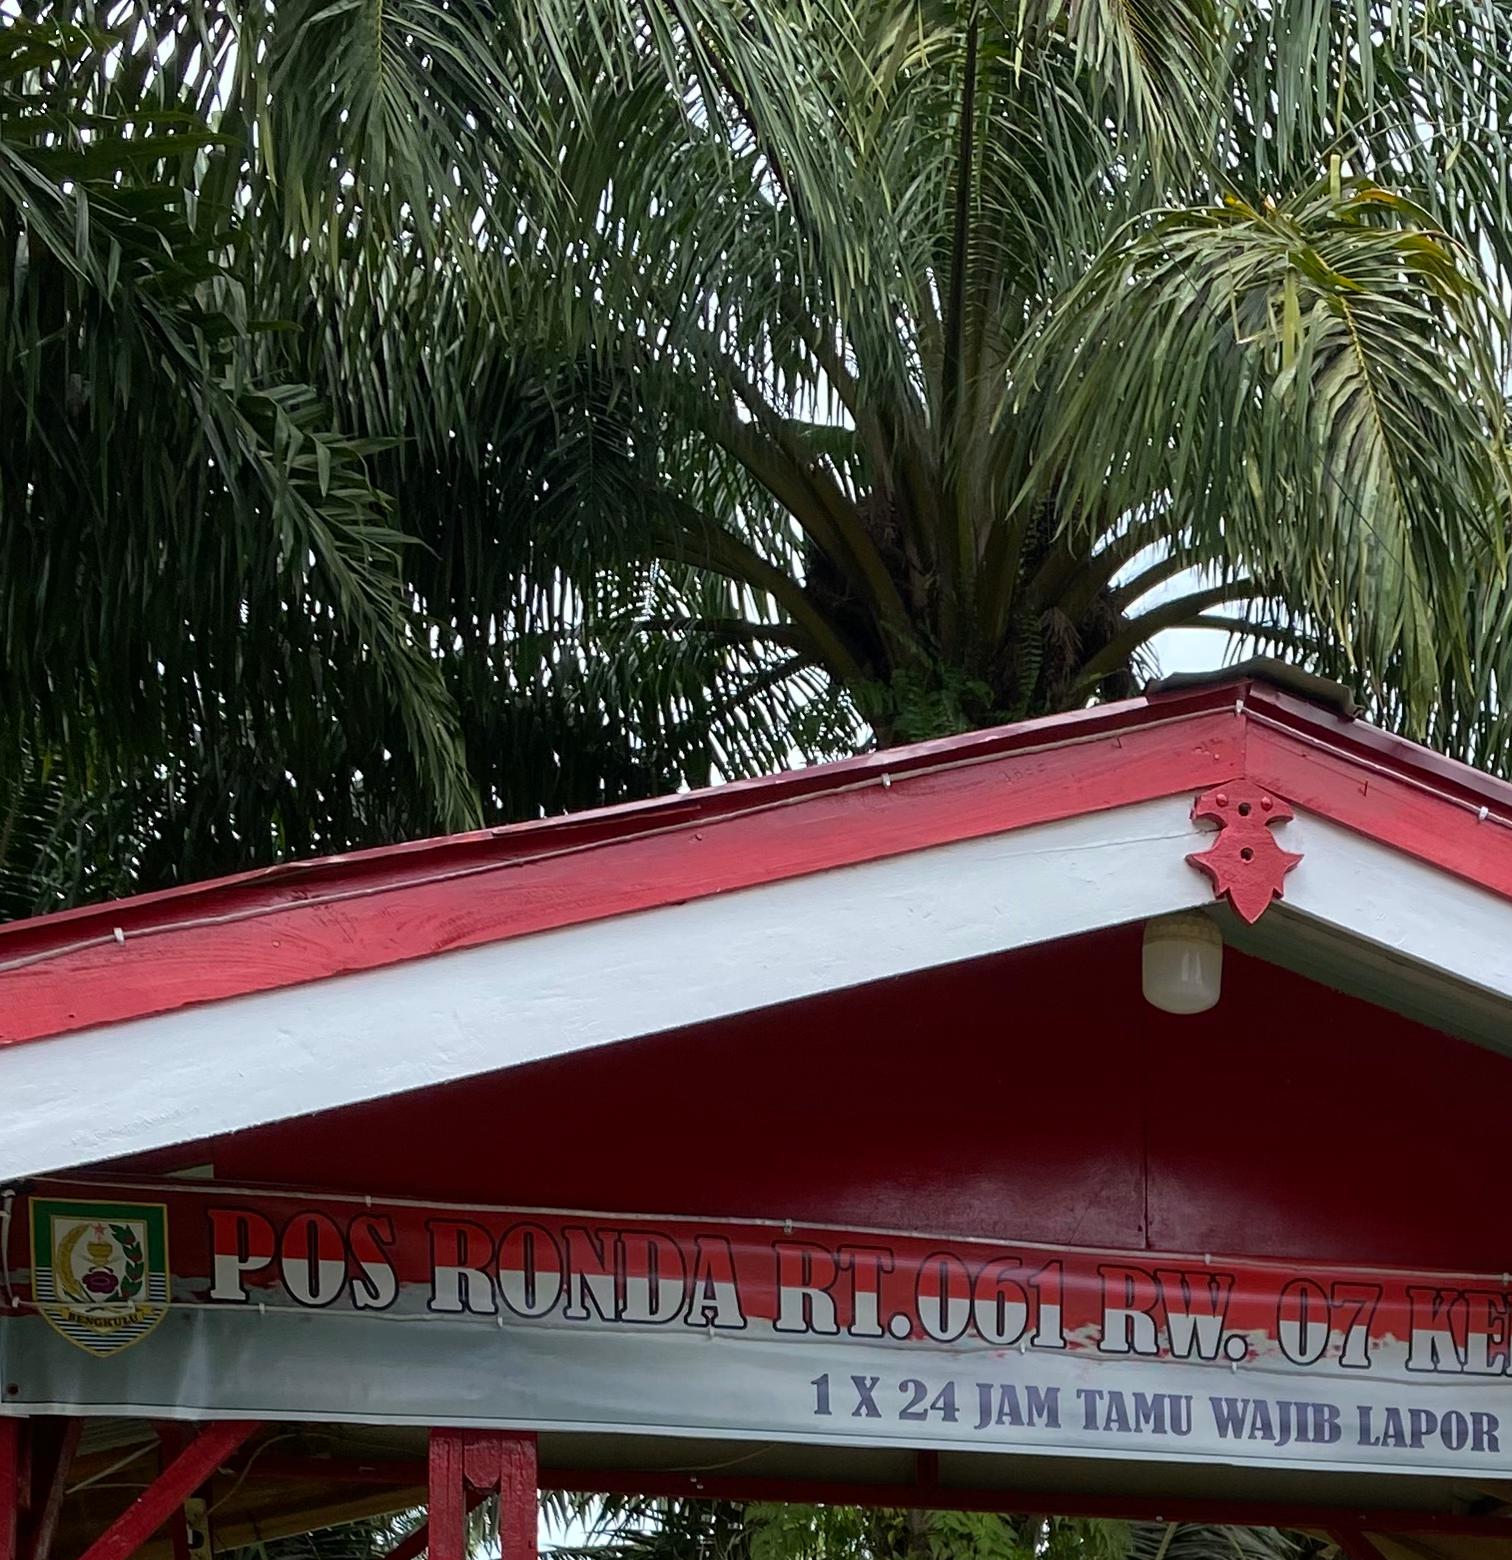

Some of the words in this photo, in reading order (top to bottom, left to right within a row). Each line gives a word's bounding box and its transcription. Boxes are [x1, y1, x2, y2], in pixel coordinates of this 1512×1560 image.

[207, 1208, 399, 1309] POS
[424, 1218, 747, 1329] RONDA
[771, 1241, 1067, 1348] RT.061
[1097, 1264, 1248, 1366] RW.
[1277, 1278, 1384, 1368] 07
[810, 1373, 833, 1416] 1
[850, 1375, 883, 1418] X
[898, 1379, 960, 1423] 24
[973, 1382, 1061, 1431] JAM
[1076, 1388, 1193, 1436] TAMU
[1208, 1396, 1341, 1447] WAJIB
[1356, 1404, 1500, 1452] LAPOR
